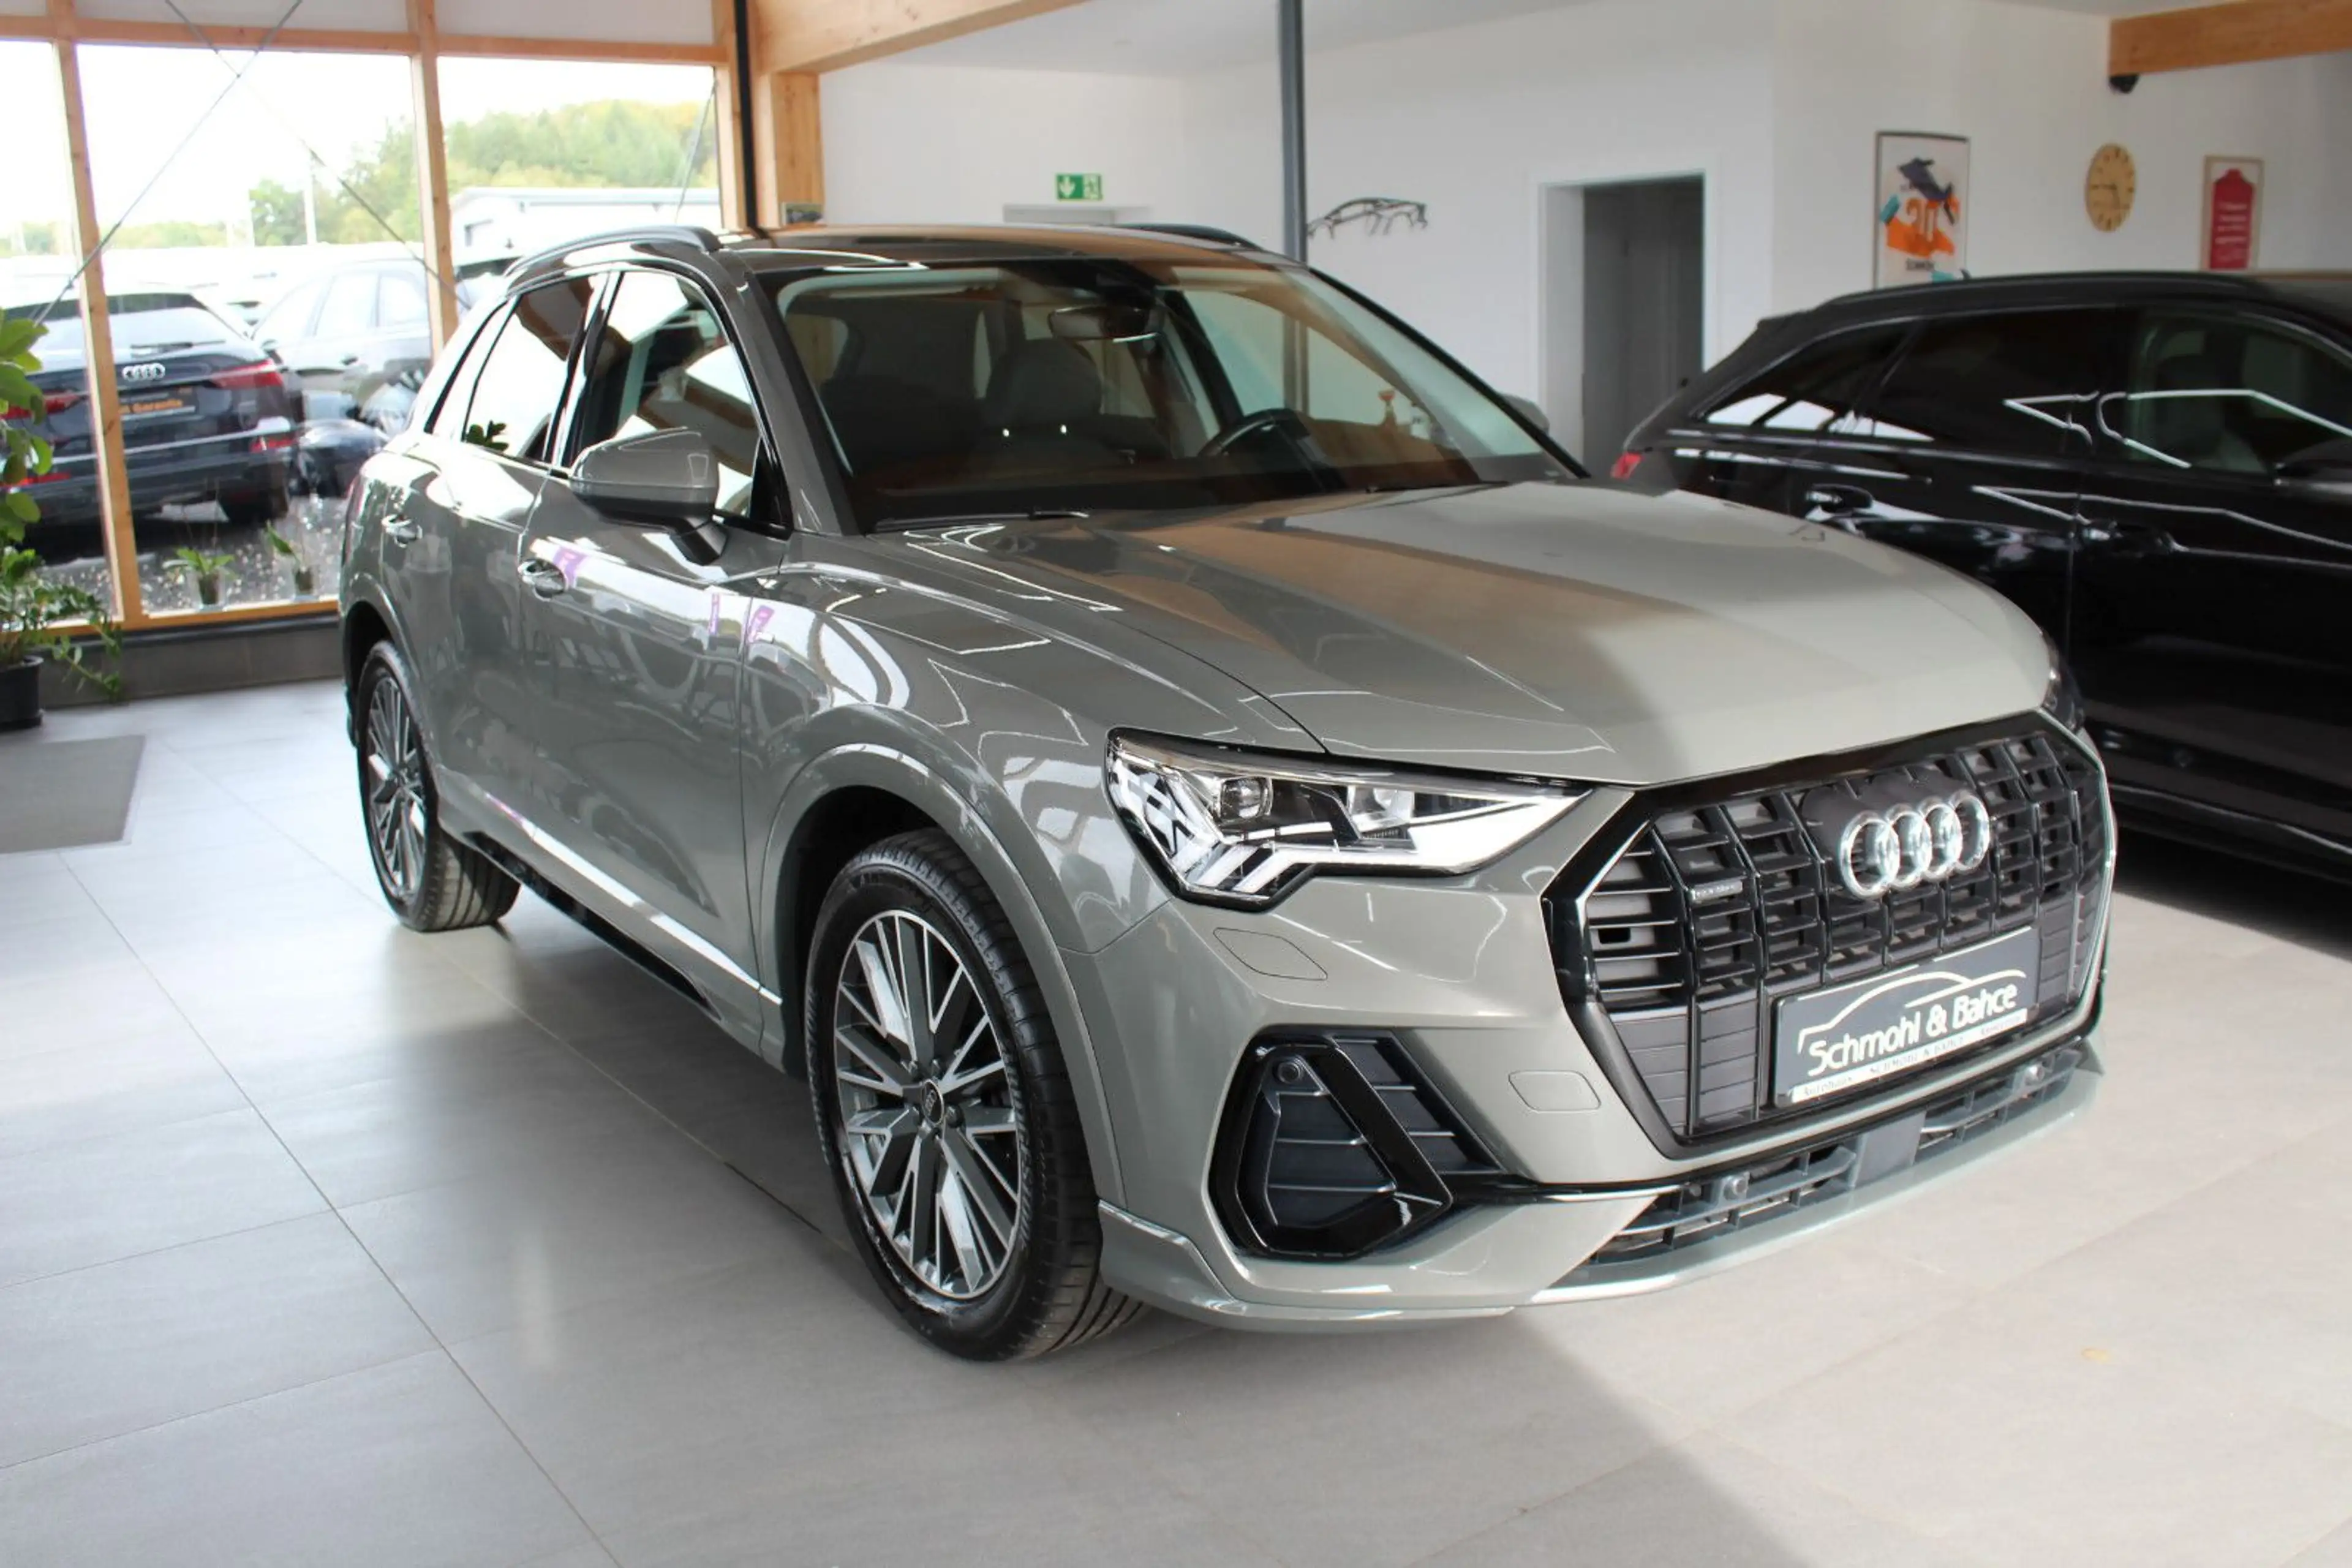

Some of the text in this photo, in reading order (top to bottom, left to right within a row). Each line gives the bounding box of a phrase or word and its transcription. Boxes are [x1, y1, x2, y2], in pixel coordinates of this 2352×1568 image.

[1807, 1011, 1921, 1076] Schmohl
[1926, 1004, 1948, 1038] &
[1952, 984, 2018, 1030] Bahce
